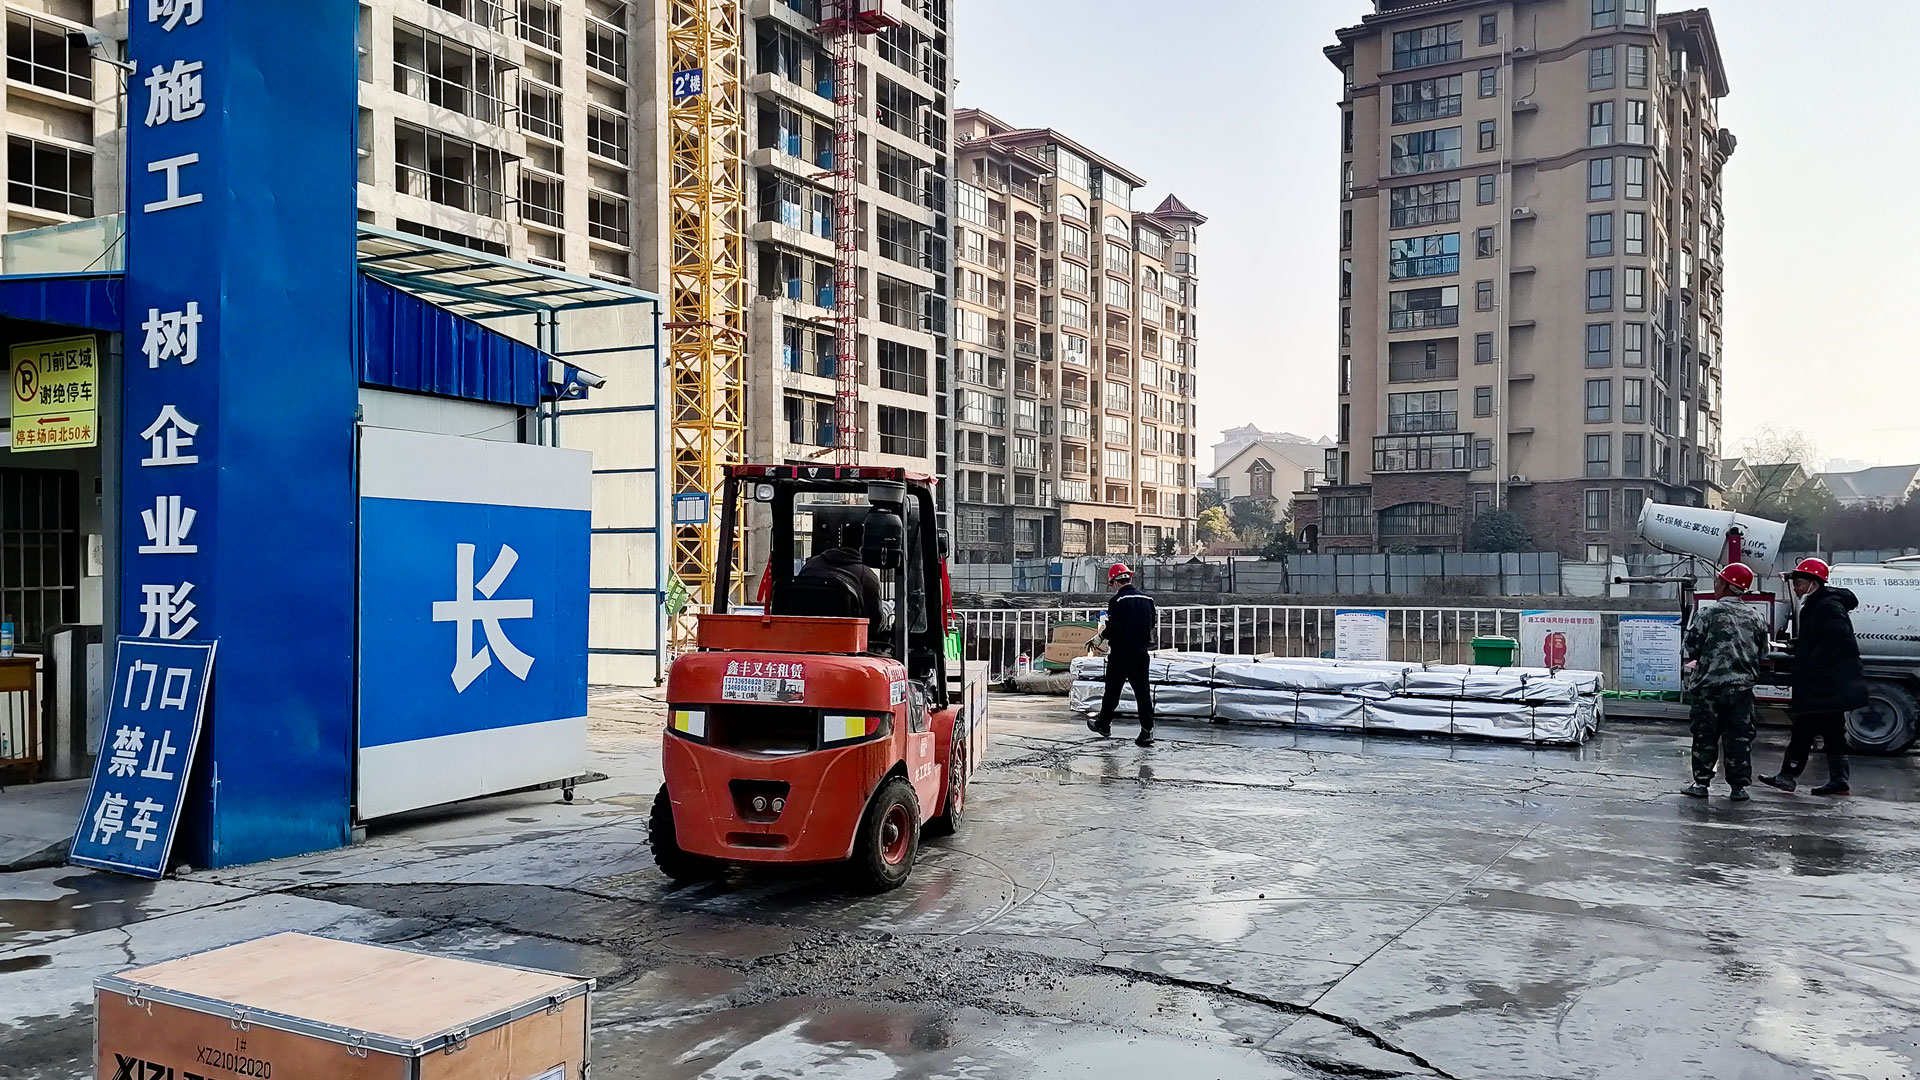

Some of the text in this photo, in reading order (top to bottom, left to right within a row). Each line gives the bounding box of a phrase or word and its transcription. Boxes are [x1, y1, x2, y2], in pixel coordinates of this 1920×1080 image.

[39, 347, 93, 373] 门前区域
[39, 381, 93, 405] 谢绝停车
[16, 424, 91, 446] 停车场向北50米
[432, 543, 536, 694] 长
[123, 659, 192, 711] 门口
[726, 660, 804, 679] 鑫丰叉车租赁
[108, 725, 177, 781] 禁止
[89, 791, 164, 851] 停车
[196, 1044, 272, 1080] XZ21012020
